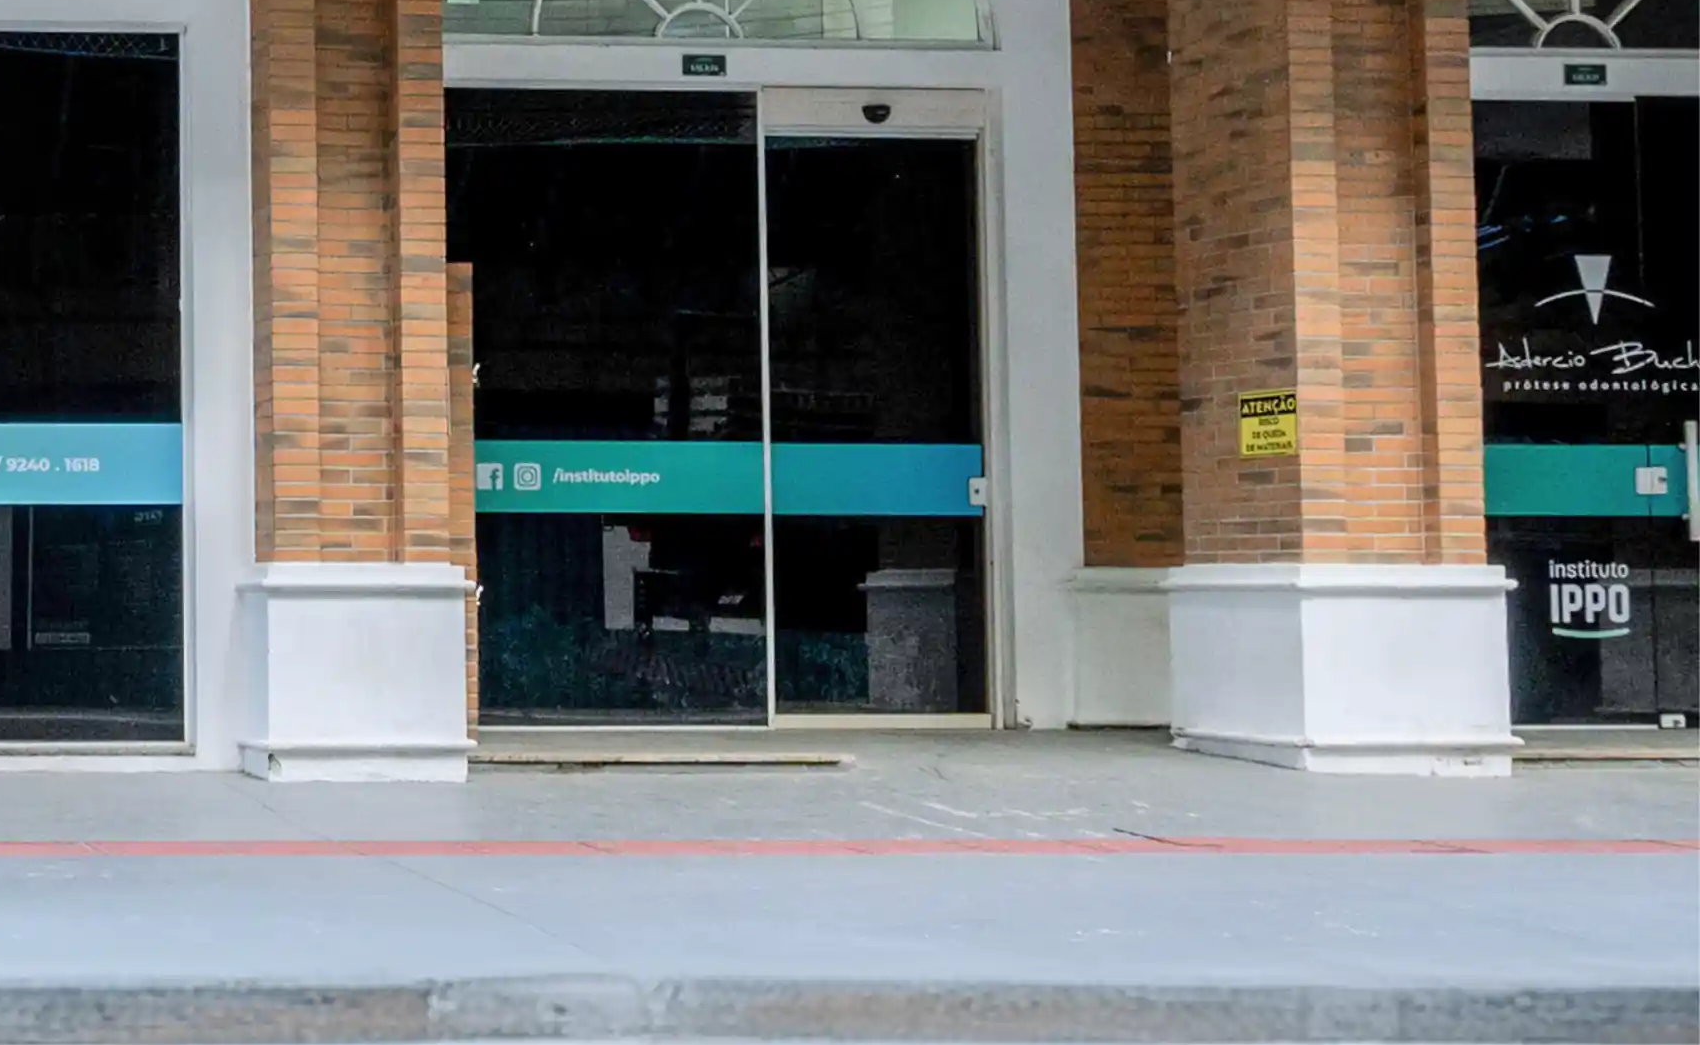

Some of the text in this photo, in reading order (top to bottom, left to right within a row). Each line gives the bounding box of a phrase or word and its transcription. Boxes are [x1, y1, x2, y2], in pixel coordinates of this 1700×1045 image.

[1503, 379, 1571, 393] prótese
[1241, 395, 1297, 416] ATENÇÃO
[6, 457, 51, 472] 9240
[64, 457, 100, 472] 1618
[1548, 559, 1629, 579] instituto
[1550, 583, 1630, 624] IPPO
